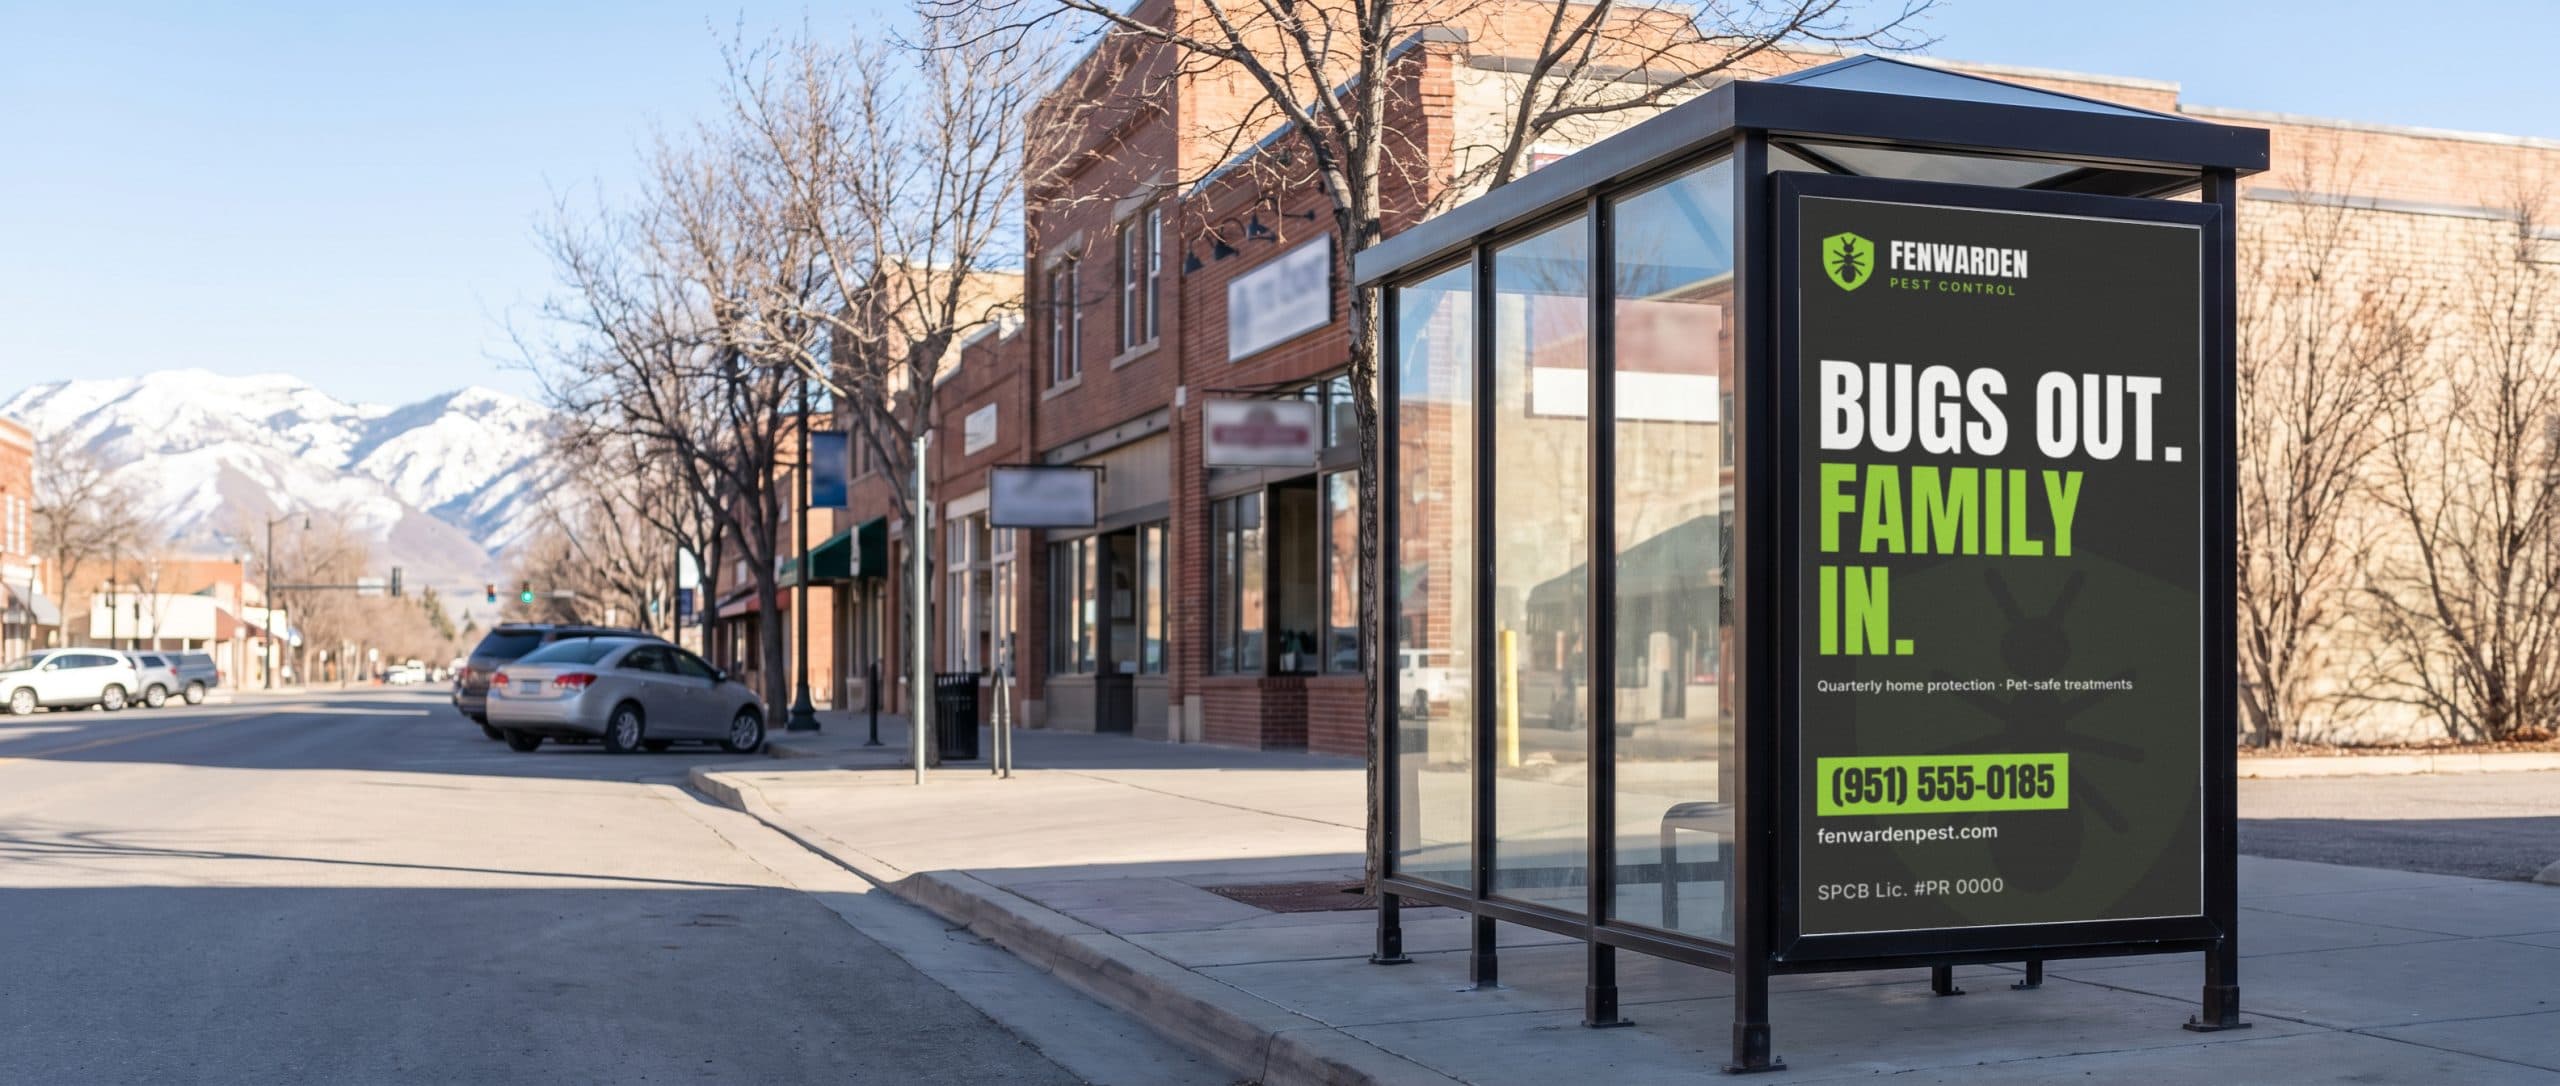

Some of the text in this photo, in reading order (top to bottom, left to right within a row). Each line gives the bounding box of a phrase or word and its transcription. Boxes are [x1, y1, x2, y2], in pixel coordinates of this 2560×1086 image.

[1890, 241, 2027, 278] FENWARDEN
[1891, 278, 2015, 295] PEST CONTROL
[1821, 360, 2181, 462] BUGS OUT.
[1821, 463, 2083, 556] FAMILY
[1820, 566, 1914, 655] IN.
[1818, 680, 1882, 694] Quarterly
[1886, 680, 1924, 691] home
[1928, 679, 1995, 693] protection
[2007, 678, 2061, 690] Pet-safe
[2064, 680, 2132, 690] treatments
[1833, 764, 2054, 807] (951) 555-0185
[1817, 826, 1997, 844] fenwardenpest.com
[1818, 878, 2003, 900] SPCB Lic. #PR 0000
